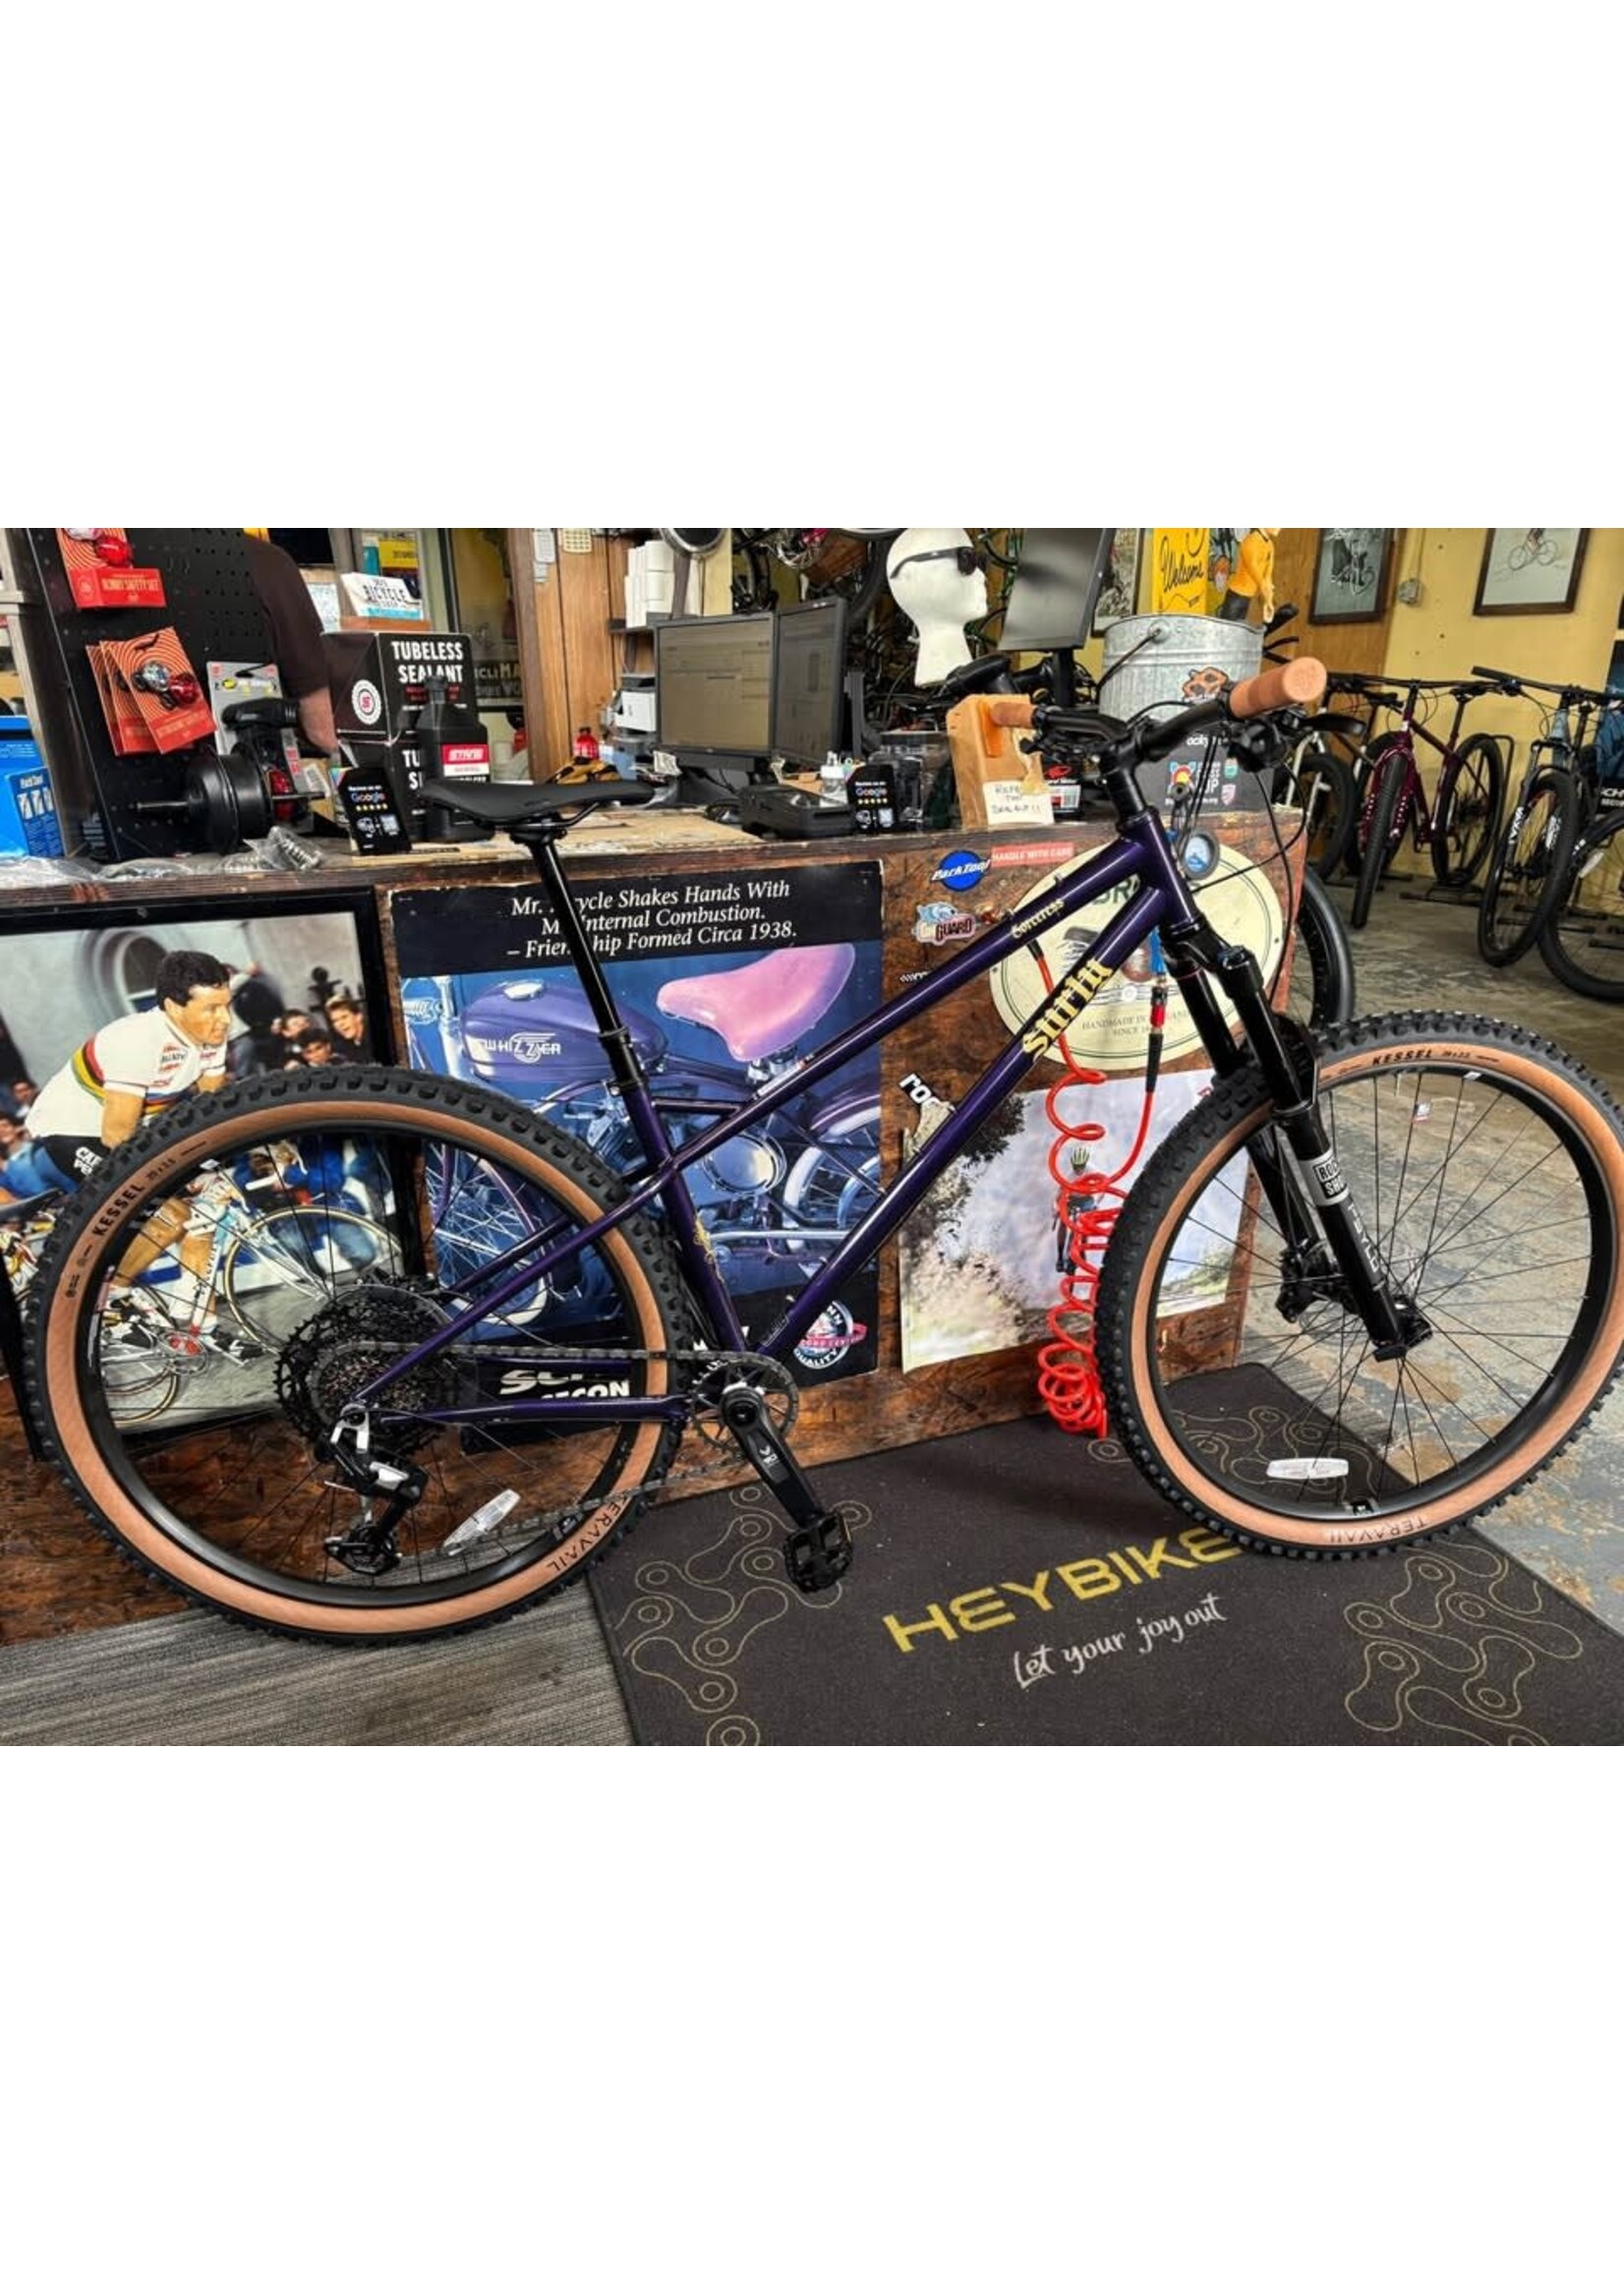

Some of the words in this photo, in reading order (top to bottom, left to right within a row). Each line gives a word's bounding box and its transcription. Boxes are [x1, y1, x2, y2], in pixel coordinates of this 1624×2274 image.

[391, 641, 464, 661] TUBELESS
[398, 665, 464, 684] SEALANT
[351, 791, 385, 803] Google
[855, 787, 888, 797] Google
[991, 851, 1024, 861] HANDLE
[511, 897, 543, 915] Mr.
[617, 888, 679, 907] Shakes
[684, 883, 741, 904] Hands
[747, 879, 790, 899] With
[655, 904, 767, 927] Combustion.
[626, 928, 693, 950] Formed
[697, 926, 743, 945] Circa
[749, 920, 797, 941] 1938.
[1372, 1049, 1432, 1065] KESSEL
[92, 1184, 145, 1236] KESSEL
[793, 1347, 838, 1367] QUALITY
[883, 1527, 1244, 1654] HEYBIKE
[1014, 1643, 1057, 1689] Let
[1061, 1631, 1127, 1674] your
[1135, 1615, 1185, 1655] joy
[1184, 1592, 1229, 1629] out
